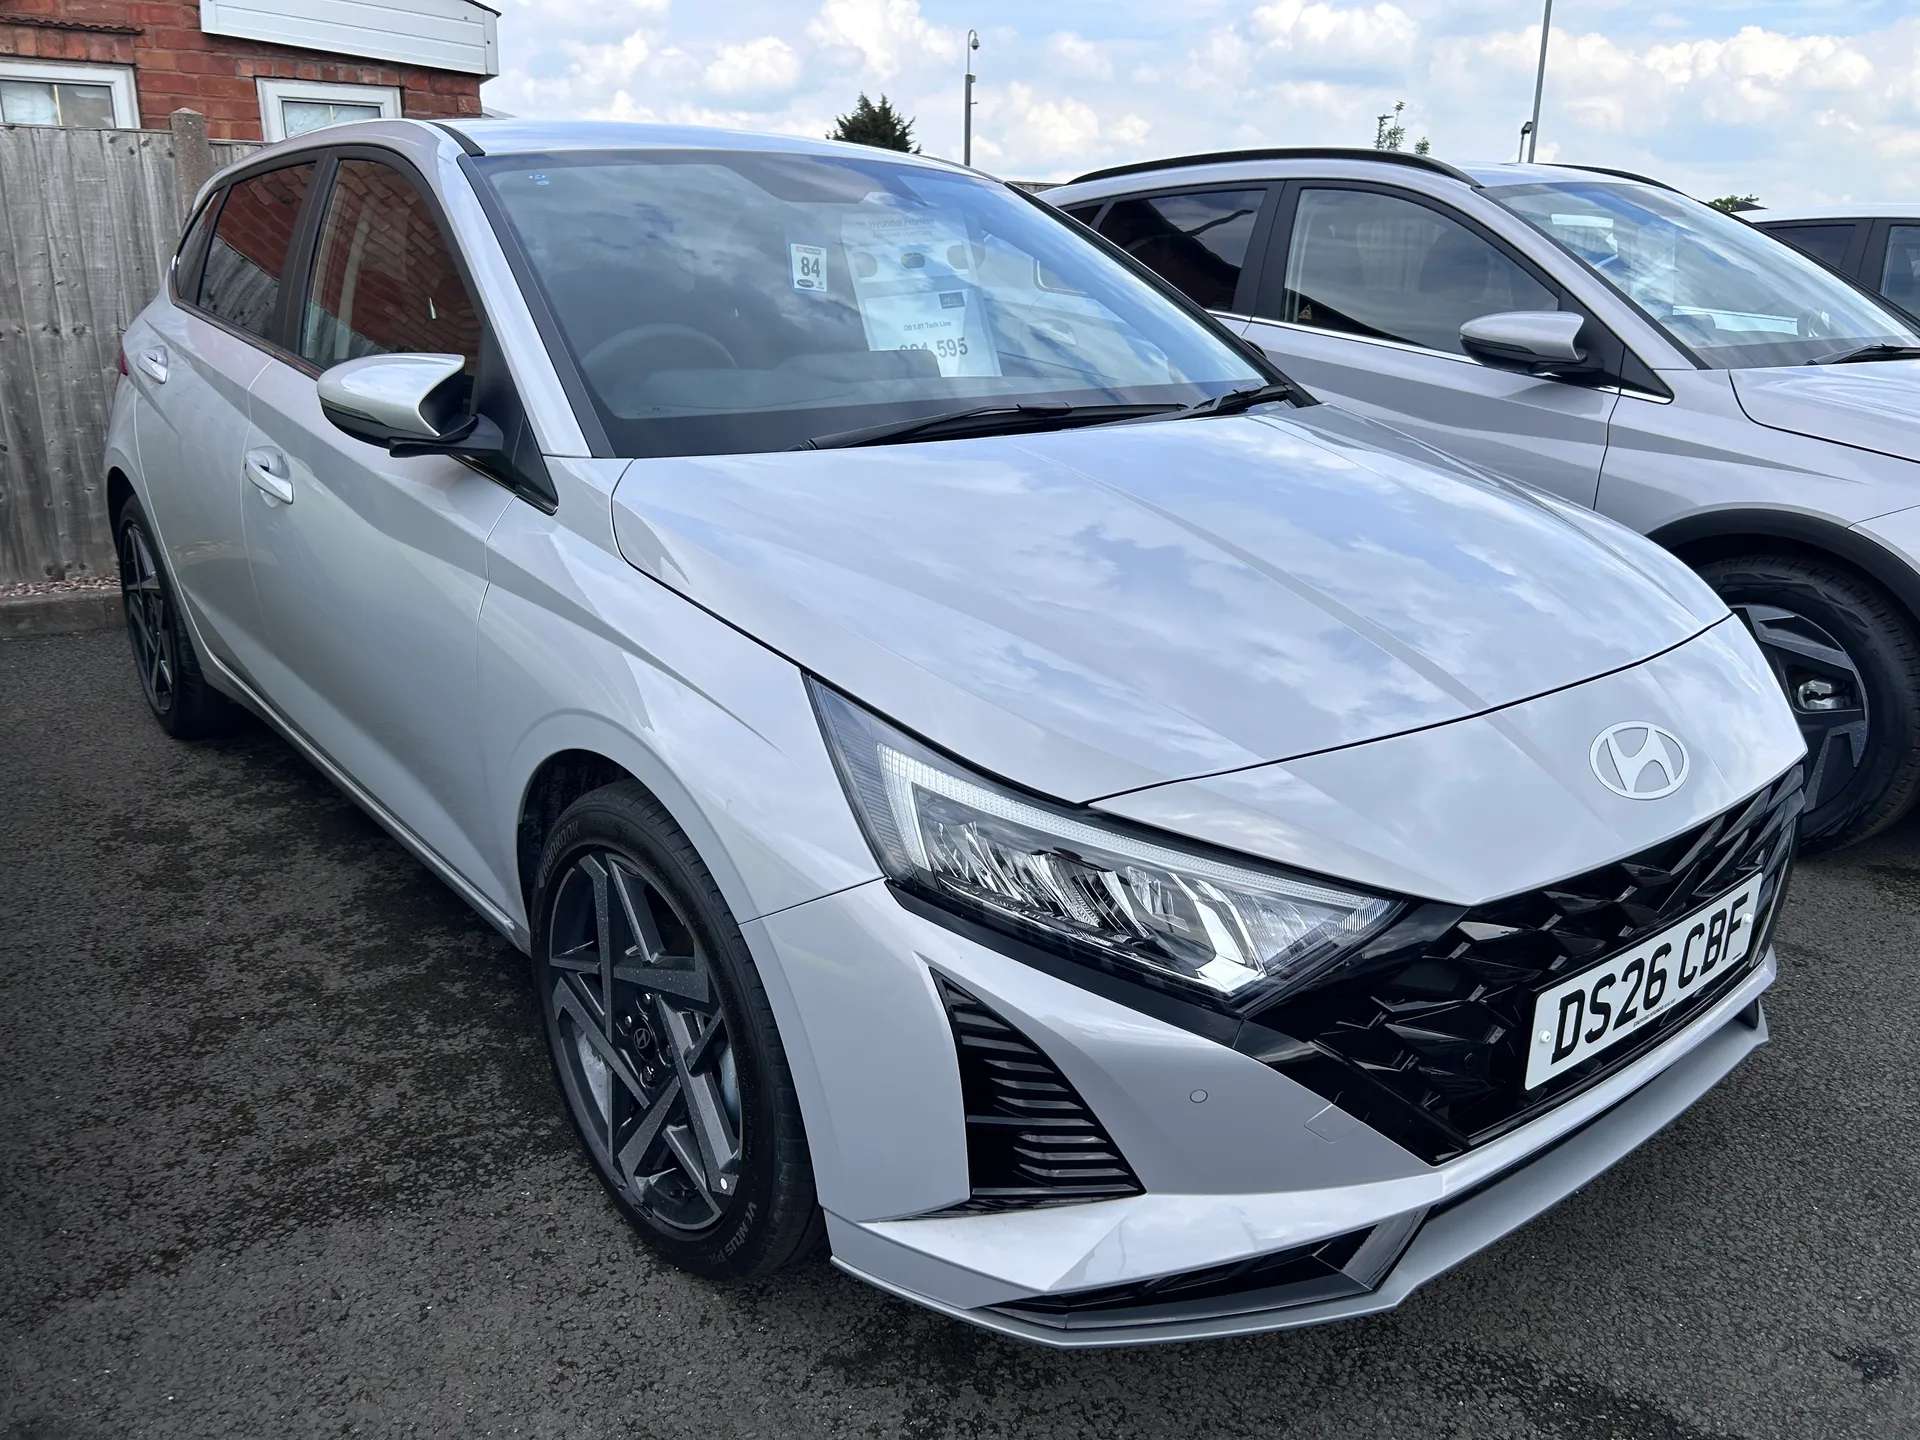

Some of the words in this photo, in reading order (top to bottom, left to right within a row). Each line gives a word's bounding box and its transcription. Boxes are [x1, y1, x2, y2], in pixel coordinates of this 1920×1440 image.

[801, 256, 820, 278] 84
[1551, 942, 1672, 1065] DS26
[1678, 891, 1750, 989] CBF
